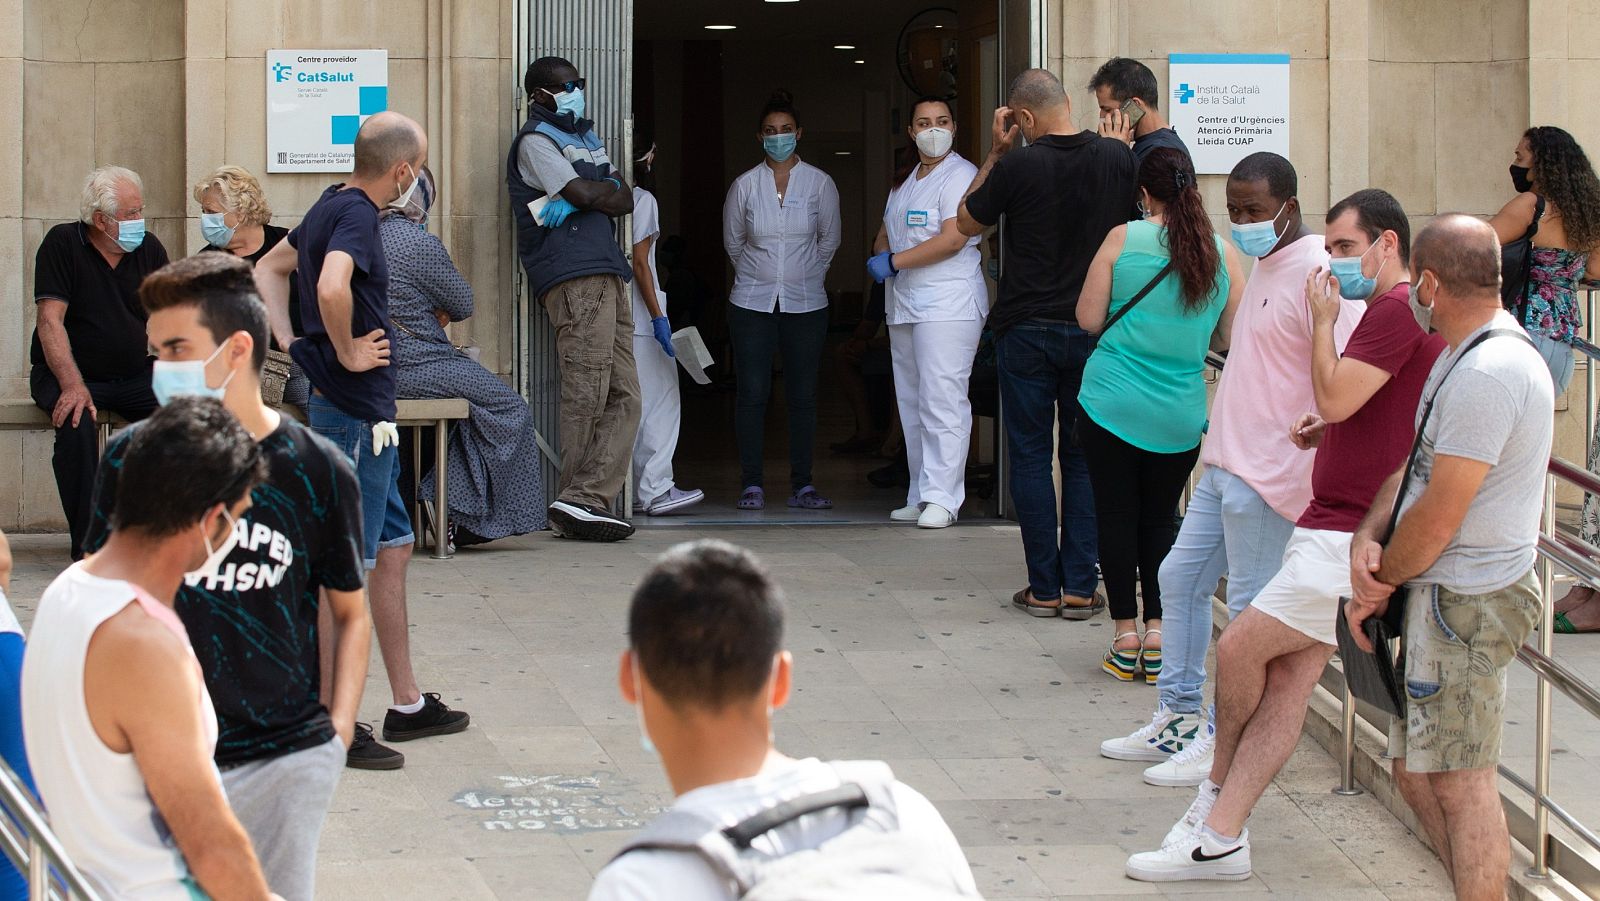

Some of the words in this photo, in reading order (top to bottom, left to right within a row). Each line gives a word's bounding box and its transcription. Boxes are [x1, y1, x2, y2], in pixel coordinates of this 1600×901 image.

[297, 72, 354, 82] CatSalut
[1197, 85, 1228, 95] Institut
[1230, 84, 1260, 95] Català
[1197, 96, 1209, 105] de
[1211, 96, 1220, 105] la
[1222, 96, 1246, 105] Salut
[1197, 116, 1228, 124] Centre
[1197, 127, 1232, 135] Atenció
[1234, 127, 1272, 135] Primària
[1197, 138, 1225, 146] Lleida
[1227, 138, 1254, 146] CUAP
[233, 518, 294, 567] APED
